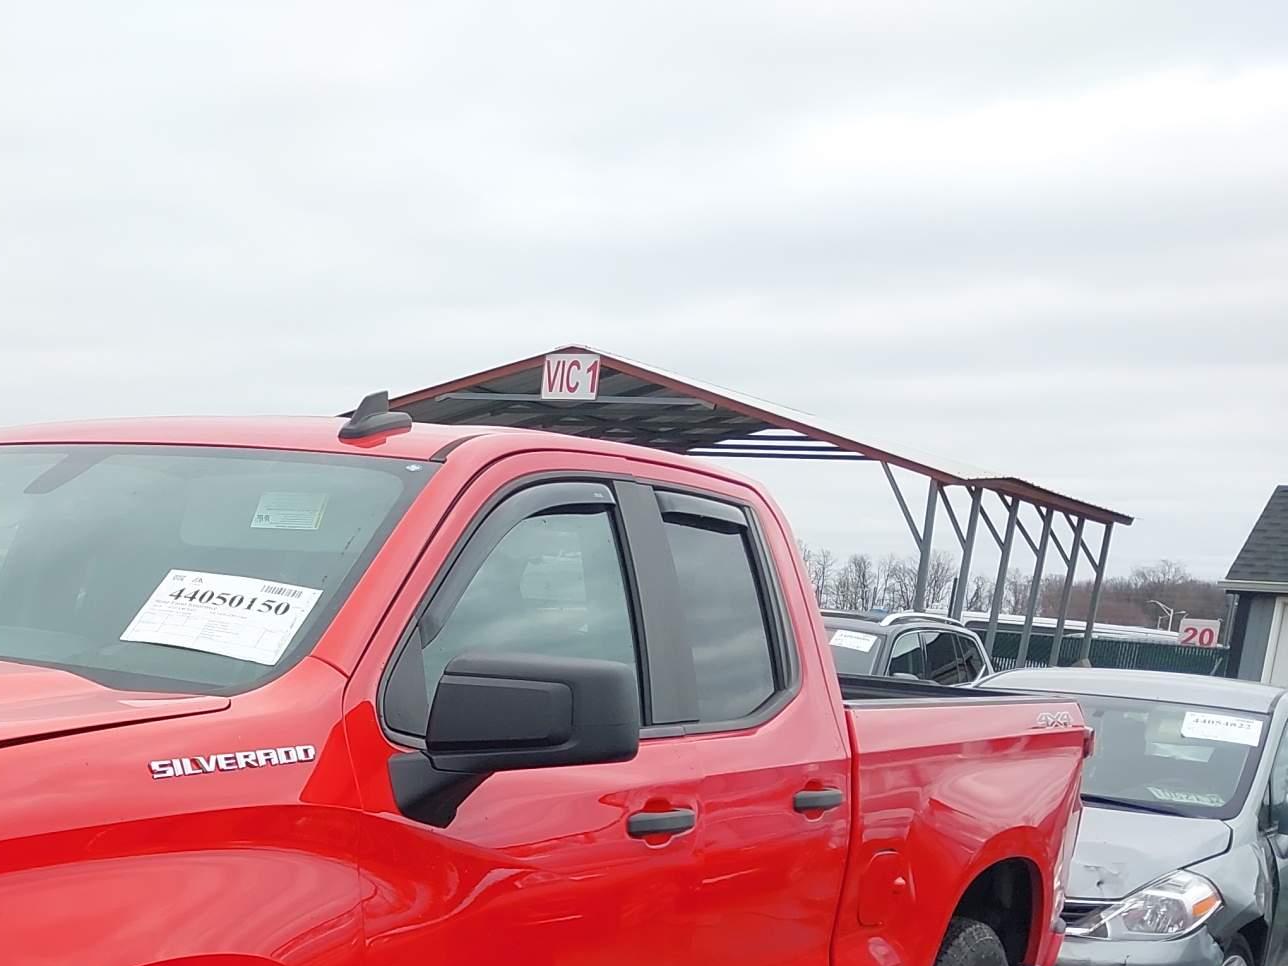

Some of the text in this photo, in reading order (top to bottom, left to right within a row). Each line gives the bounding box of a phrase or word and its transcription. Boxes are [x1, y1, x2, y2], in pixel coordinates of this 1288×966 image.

[546, 359, 599, 393] VIC 1
[169, 587, 290, 616] 44050150
[1180, 626, 1215, 647] 20
[148, 745, 316, 779] SILVERADO
